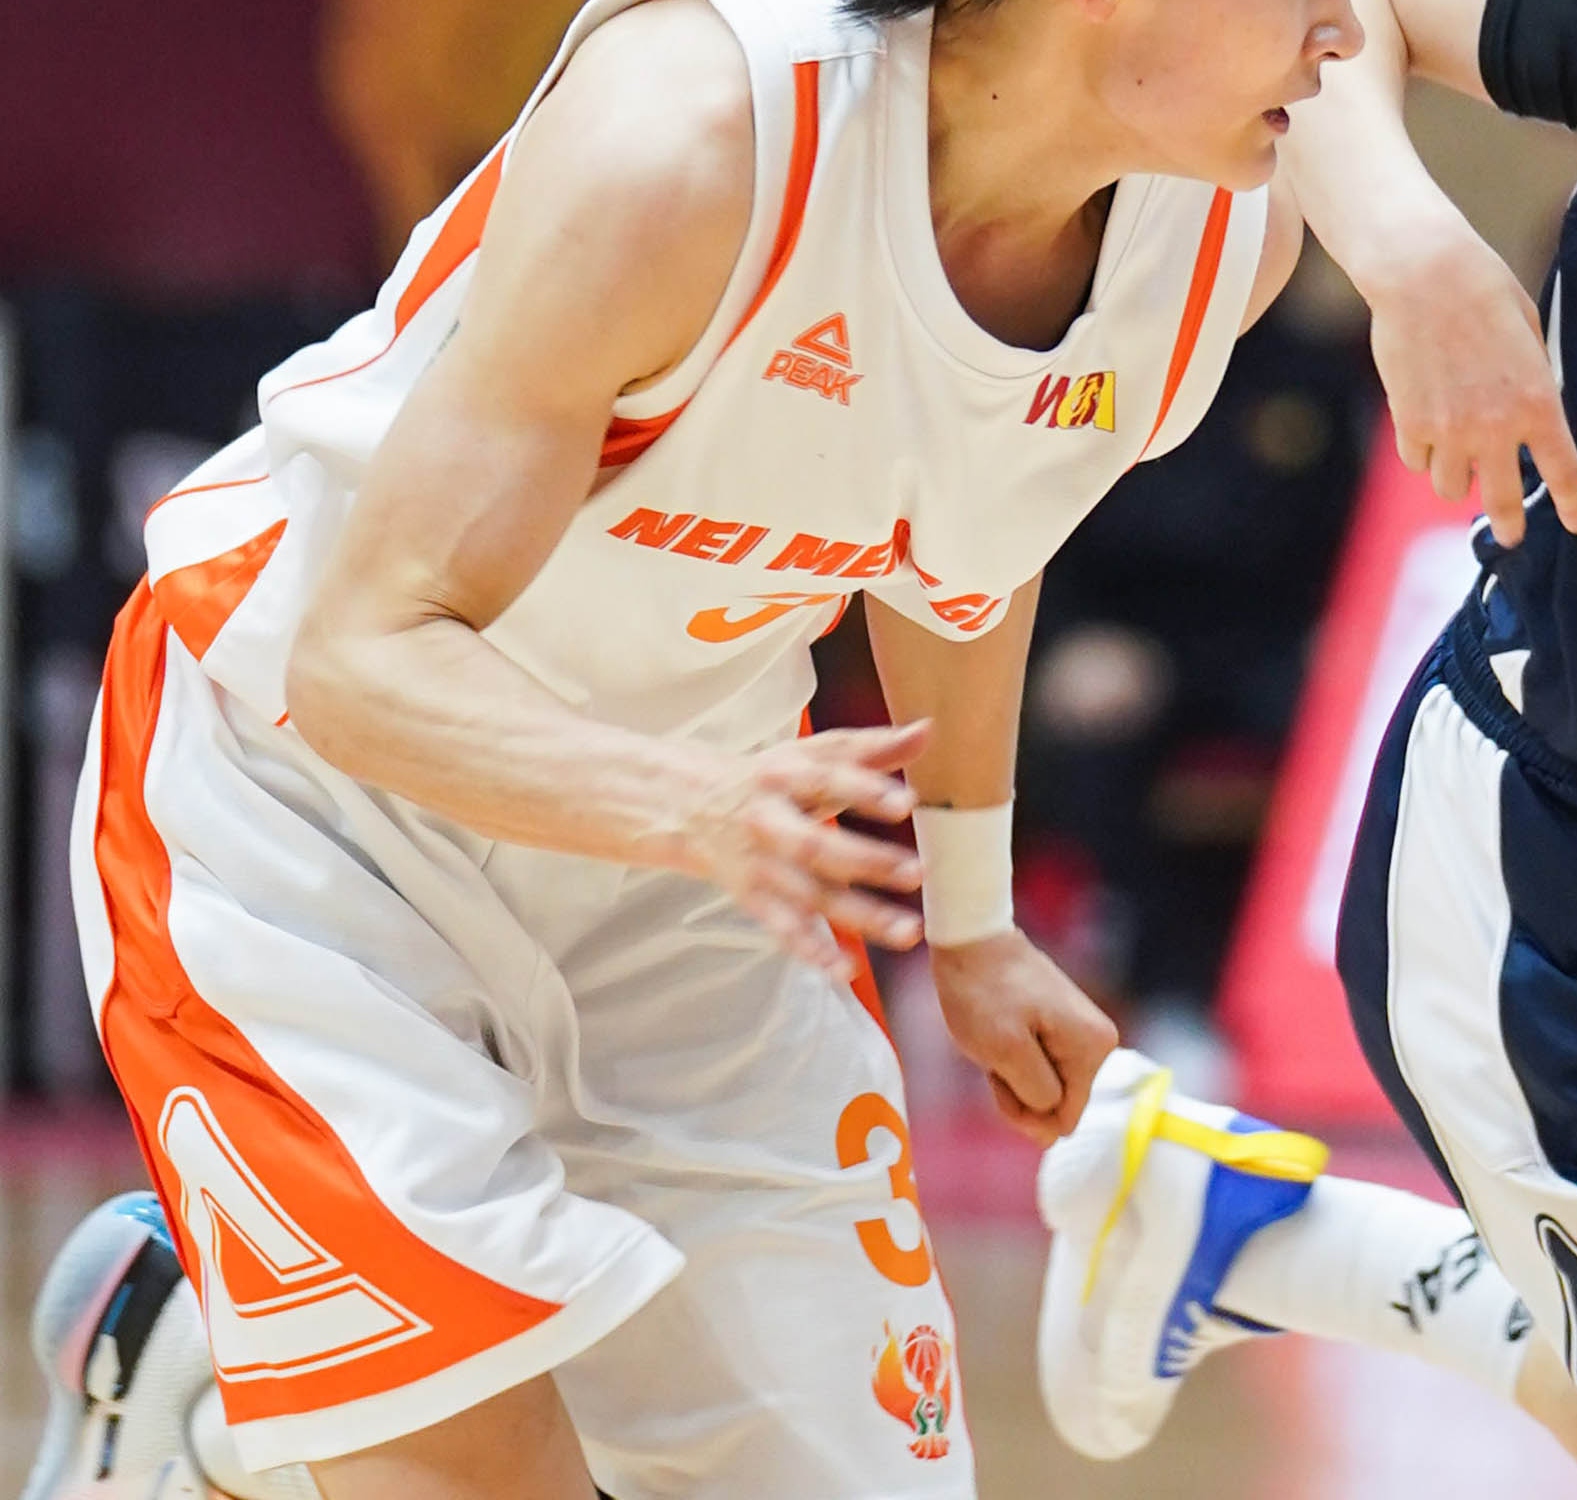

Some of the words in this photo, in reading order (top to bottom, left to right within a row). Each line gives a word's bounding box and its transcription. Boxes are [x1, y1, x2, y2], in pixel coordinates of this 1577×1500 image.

[762, 349, 862, 406] PEAK
[606, 506, 770, 566] NEI
[836, 1092, 932, 1288] 3
